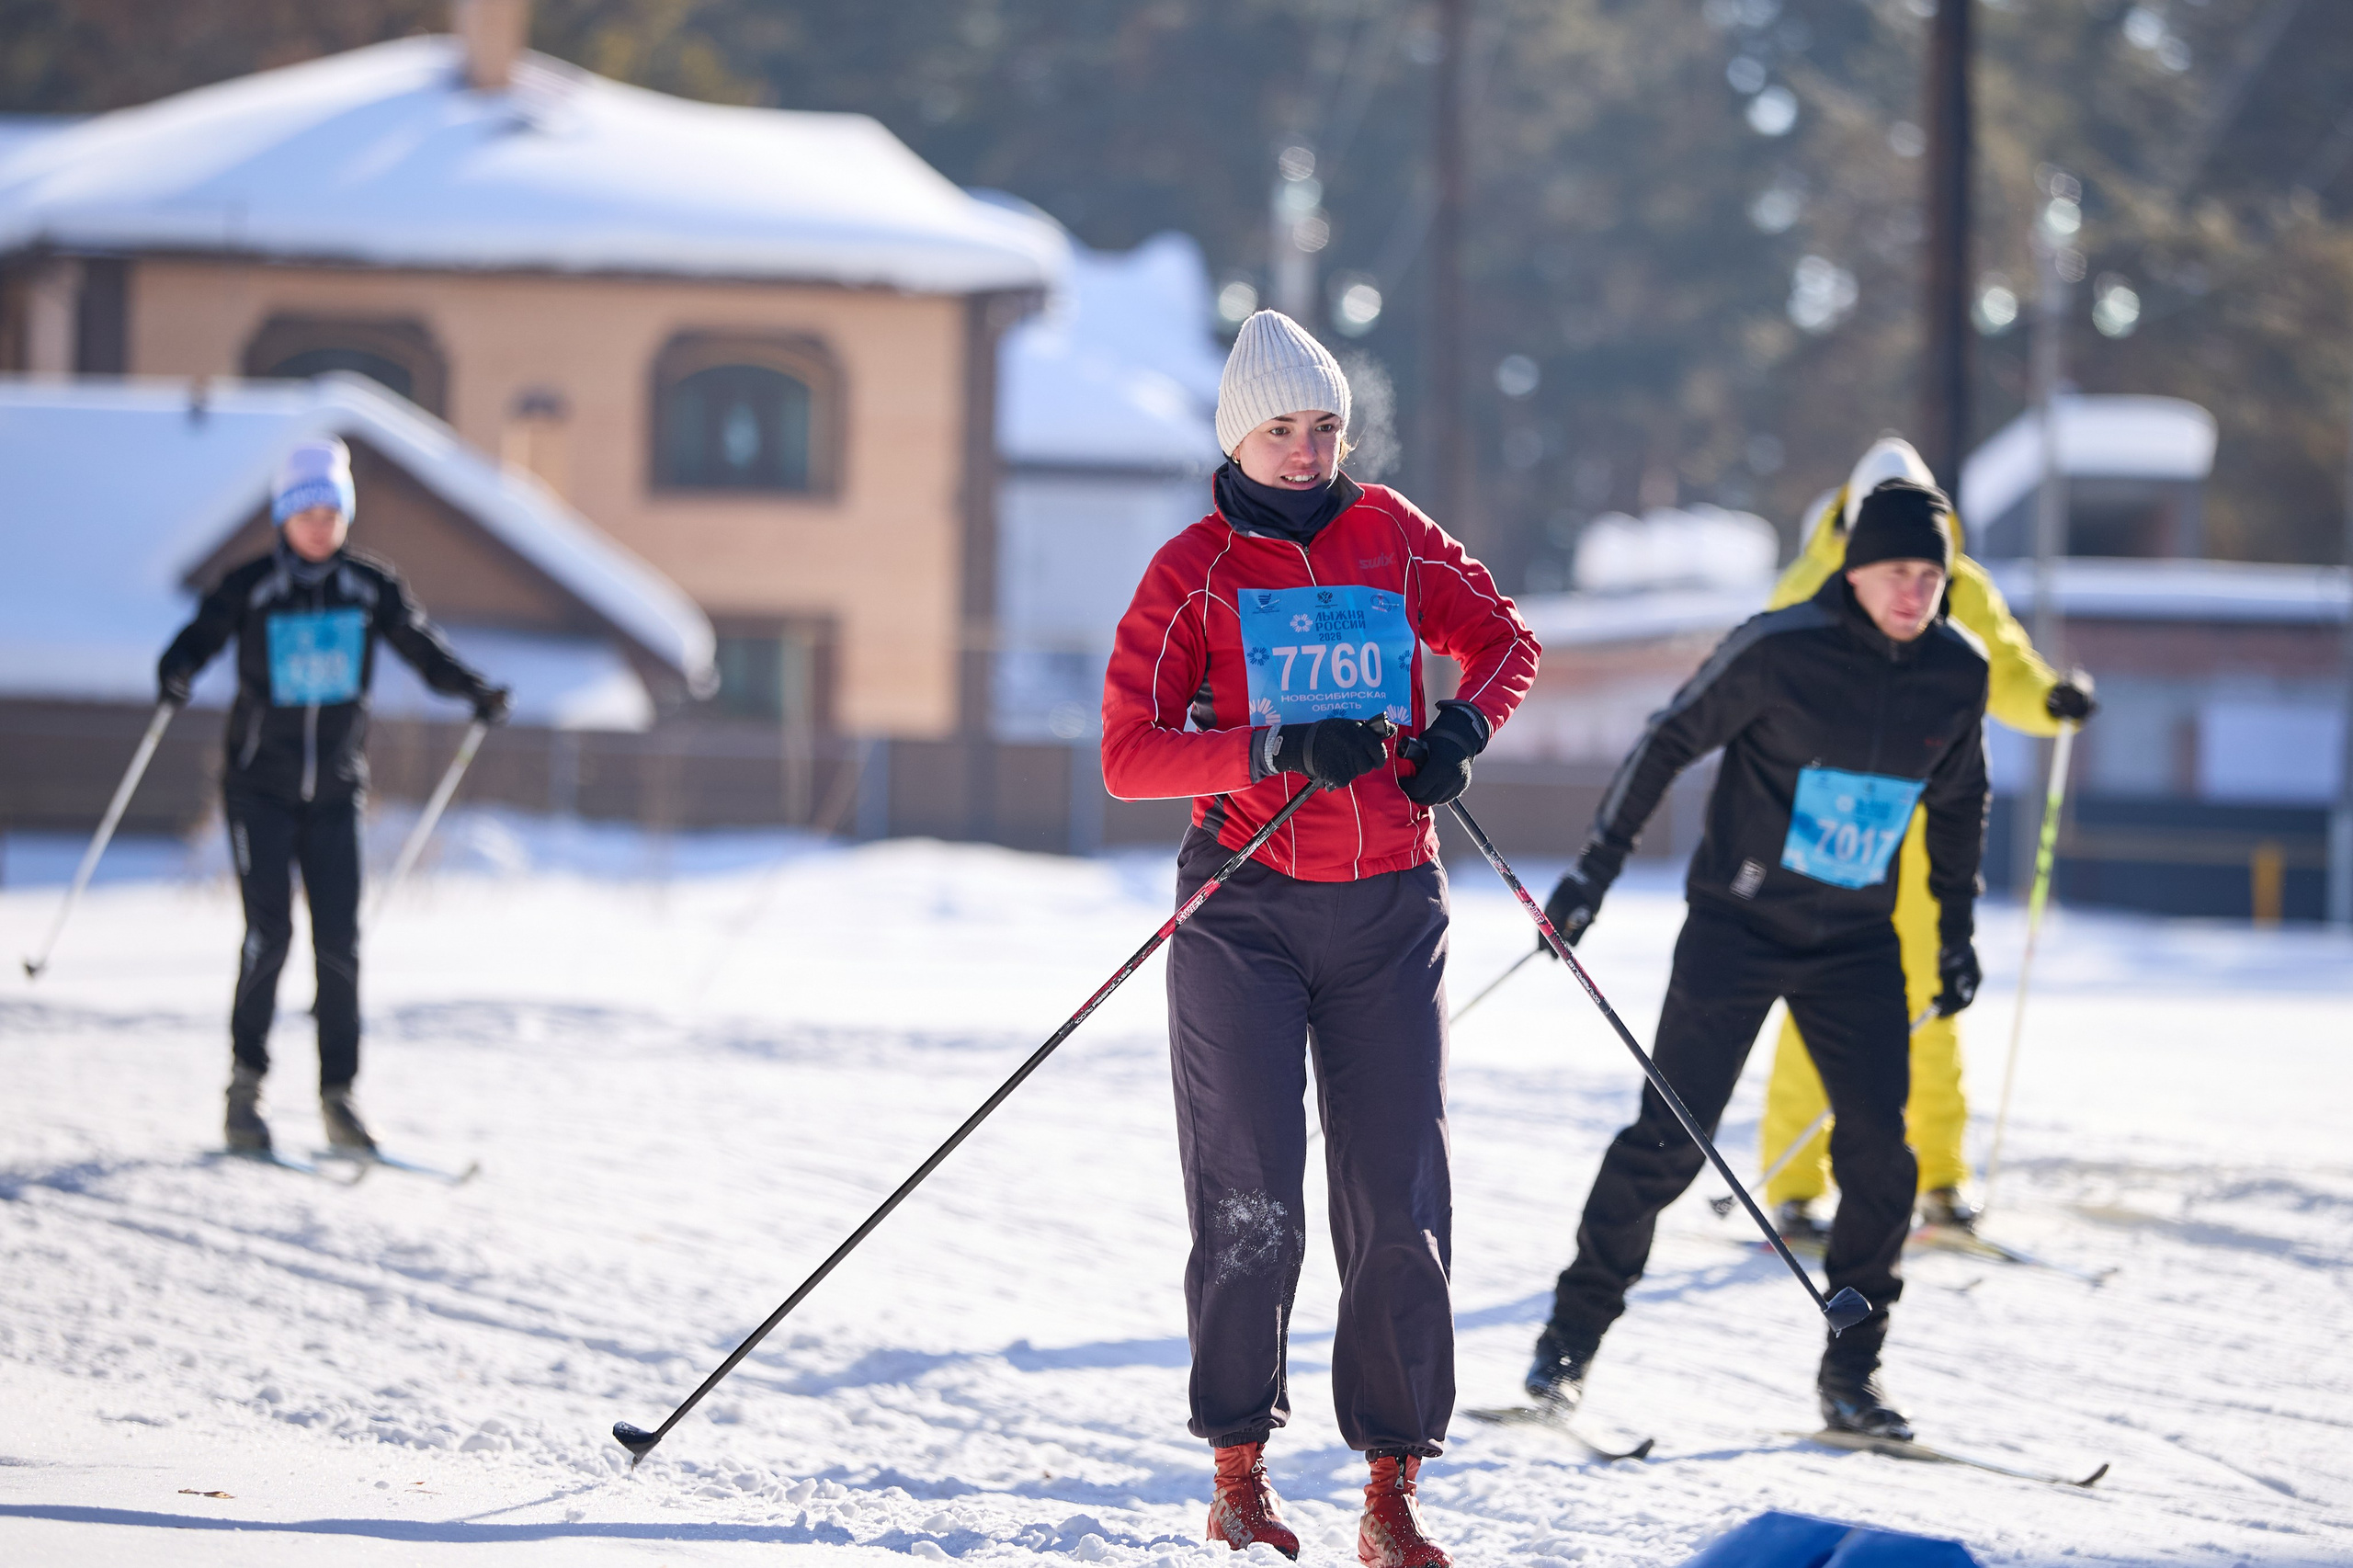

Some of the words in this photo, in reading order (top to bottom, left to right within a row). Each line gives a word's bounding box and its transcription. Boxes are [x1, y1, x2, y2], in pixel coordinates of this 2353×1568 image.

[1315, 609, 1365, 622] ЛЫЖНЯ
[1315, 619, 1366, 632] РОССИИ
[1318, 631, 1342, 642] 2026
[1272, 642, 1382, 691] 7760
[1280, 690, 1387, 703] НОВОСИБИРСКАЯ
[1312, 701, 1362, 712] ОБЛАСТЬ
[1815, 818, 1897, 869] 7017
